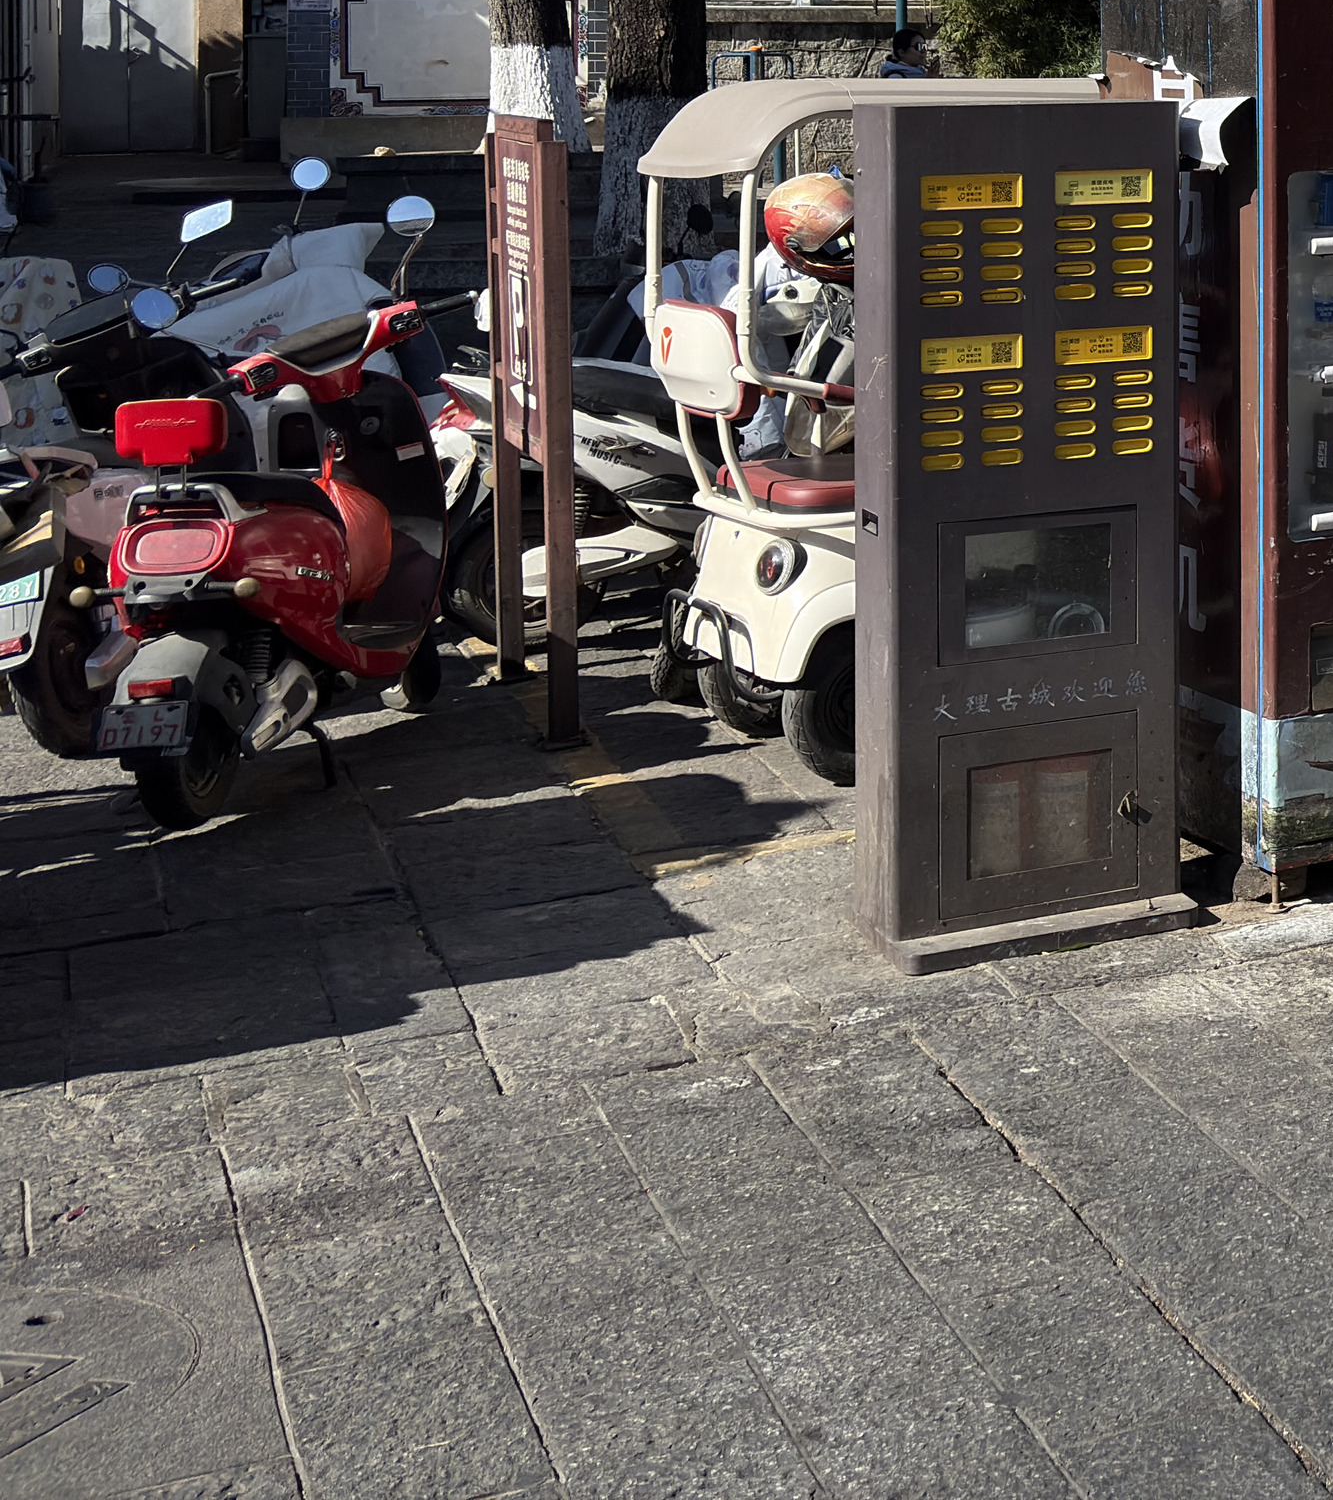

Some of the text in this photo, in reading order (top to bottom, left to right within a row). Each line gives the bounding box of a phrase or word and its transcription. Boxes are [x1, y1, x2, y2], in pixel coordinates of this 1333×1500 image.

[580, 436, 602, 449] NEW
[588, 446, 622, 465] MUSIC
[932, 668, 1149, 722] 大理古城欢迎您
[103, 723, 180, 746] D7197
